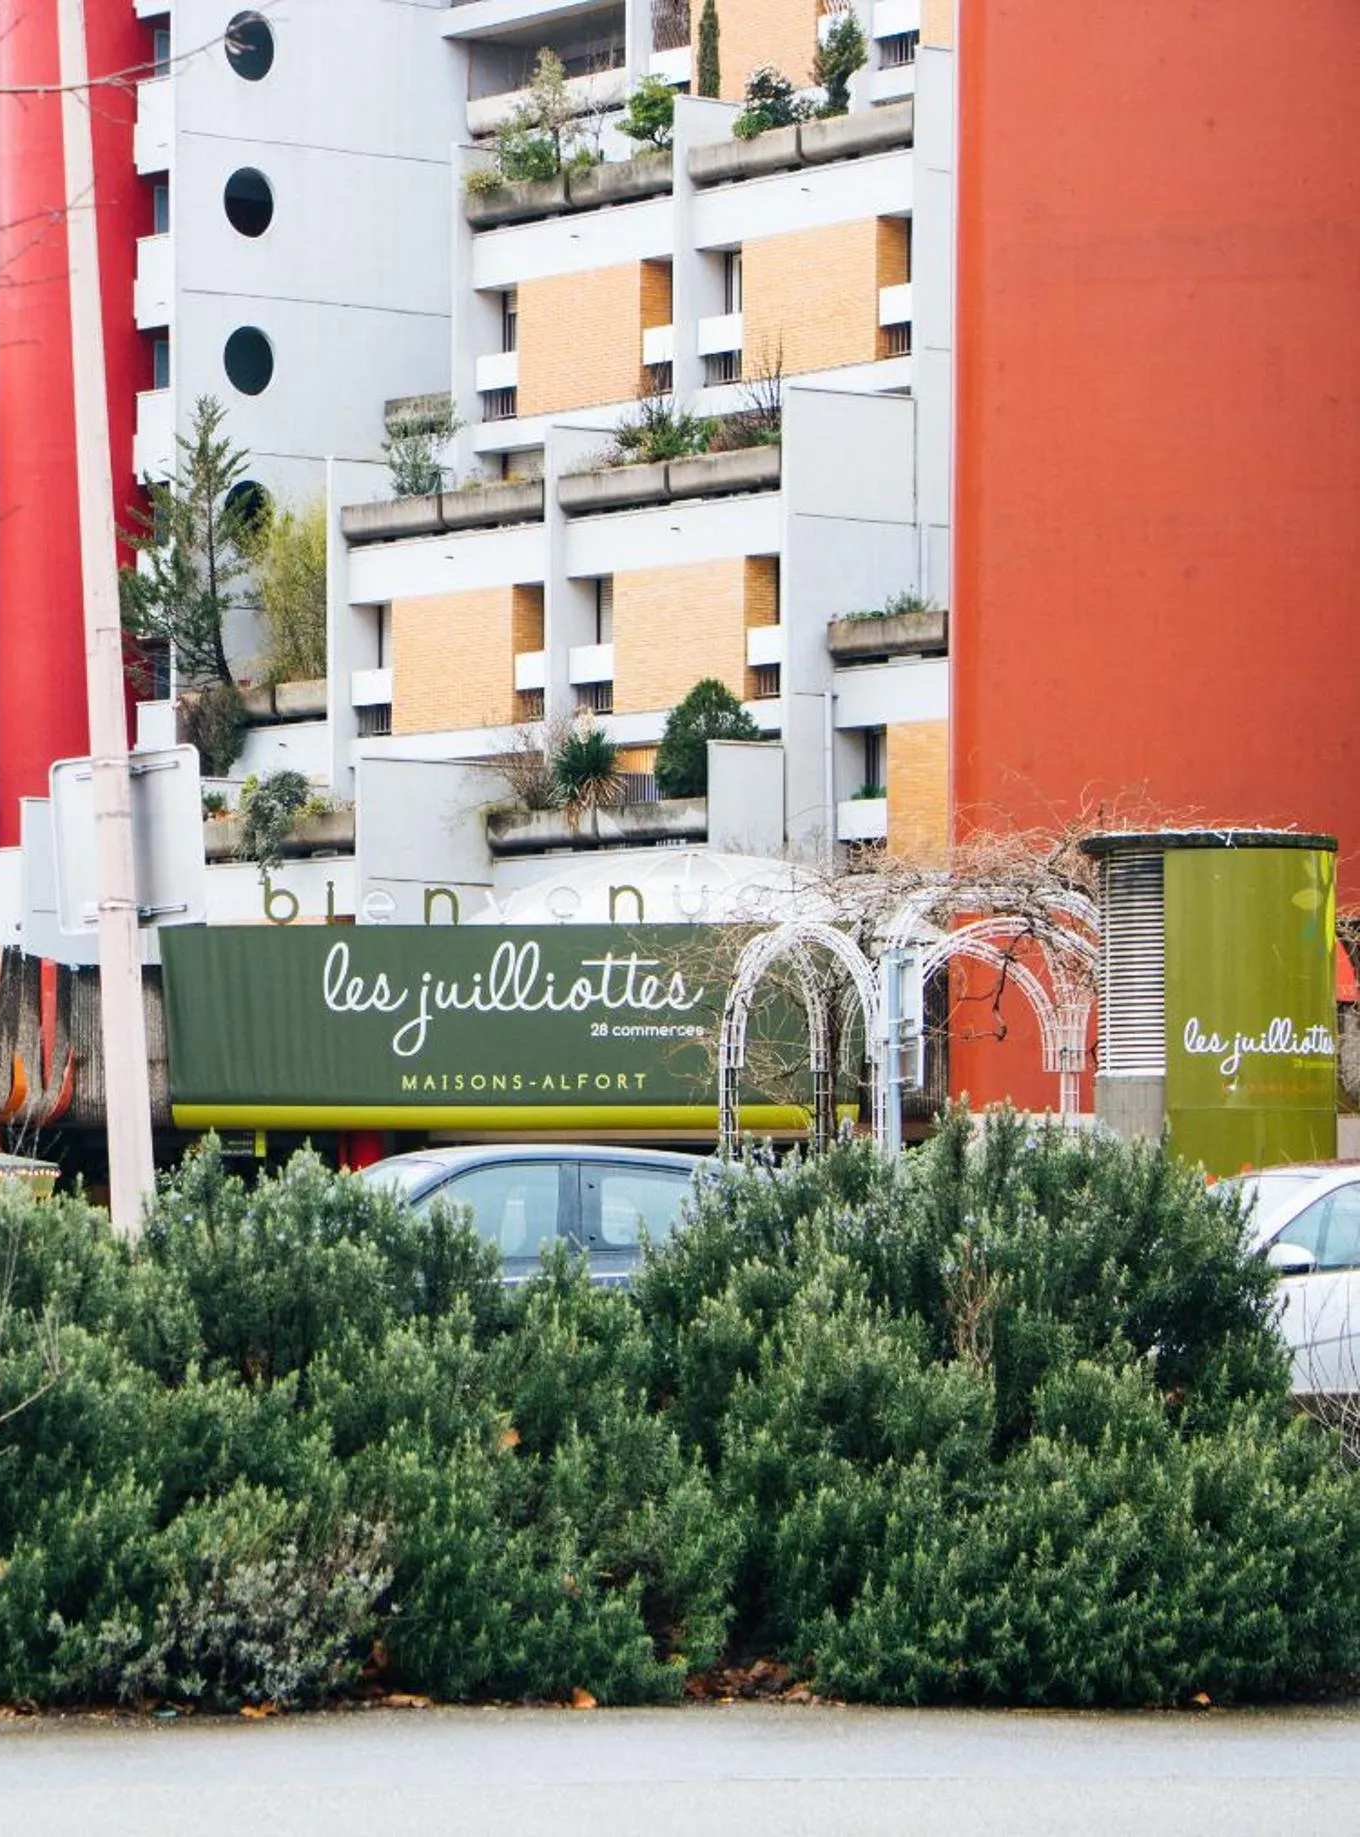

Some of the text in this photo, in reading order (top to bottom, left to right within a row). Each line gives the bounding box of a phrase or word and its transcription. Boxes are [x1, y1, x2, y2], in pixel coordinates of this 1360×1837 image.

[323, 940, 704, 1057] les juilliottes
[590, 1022, 705, 1037] 28 commerces
[1183, 1016, 1229, 1053] les
[401, 1073, 647, 1091] MAISONS-ALFORT
